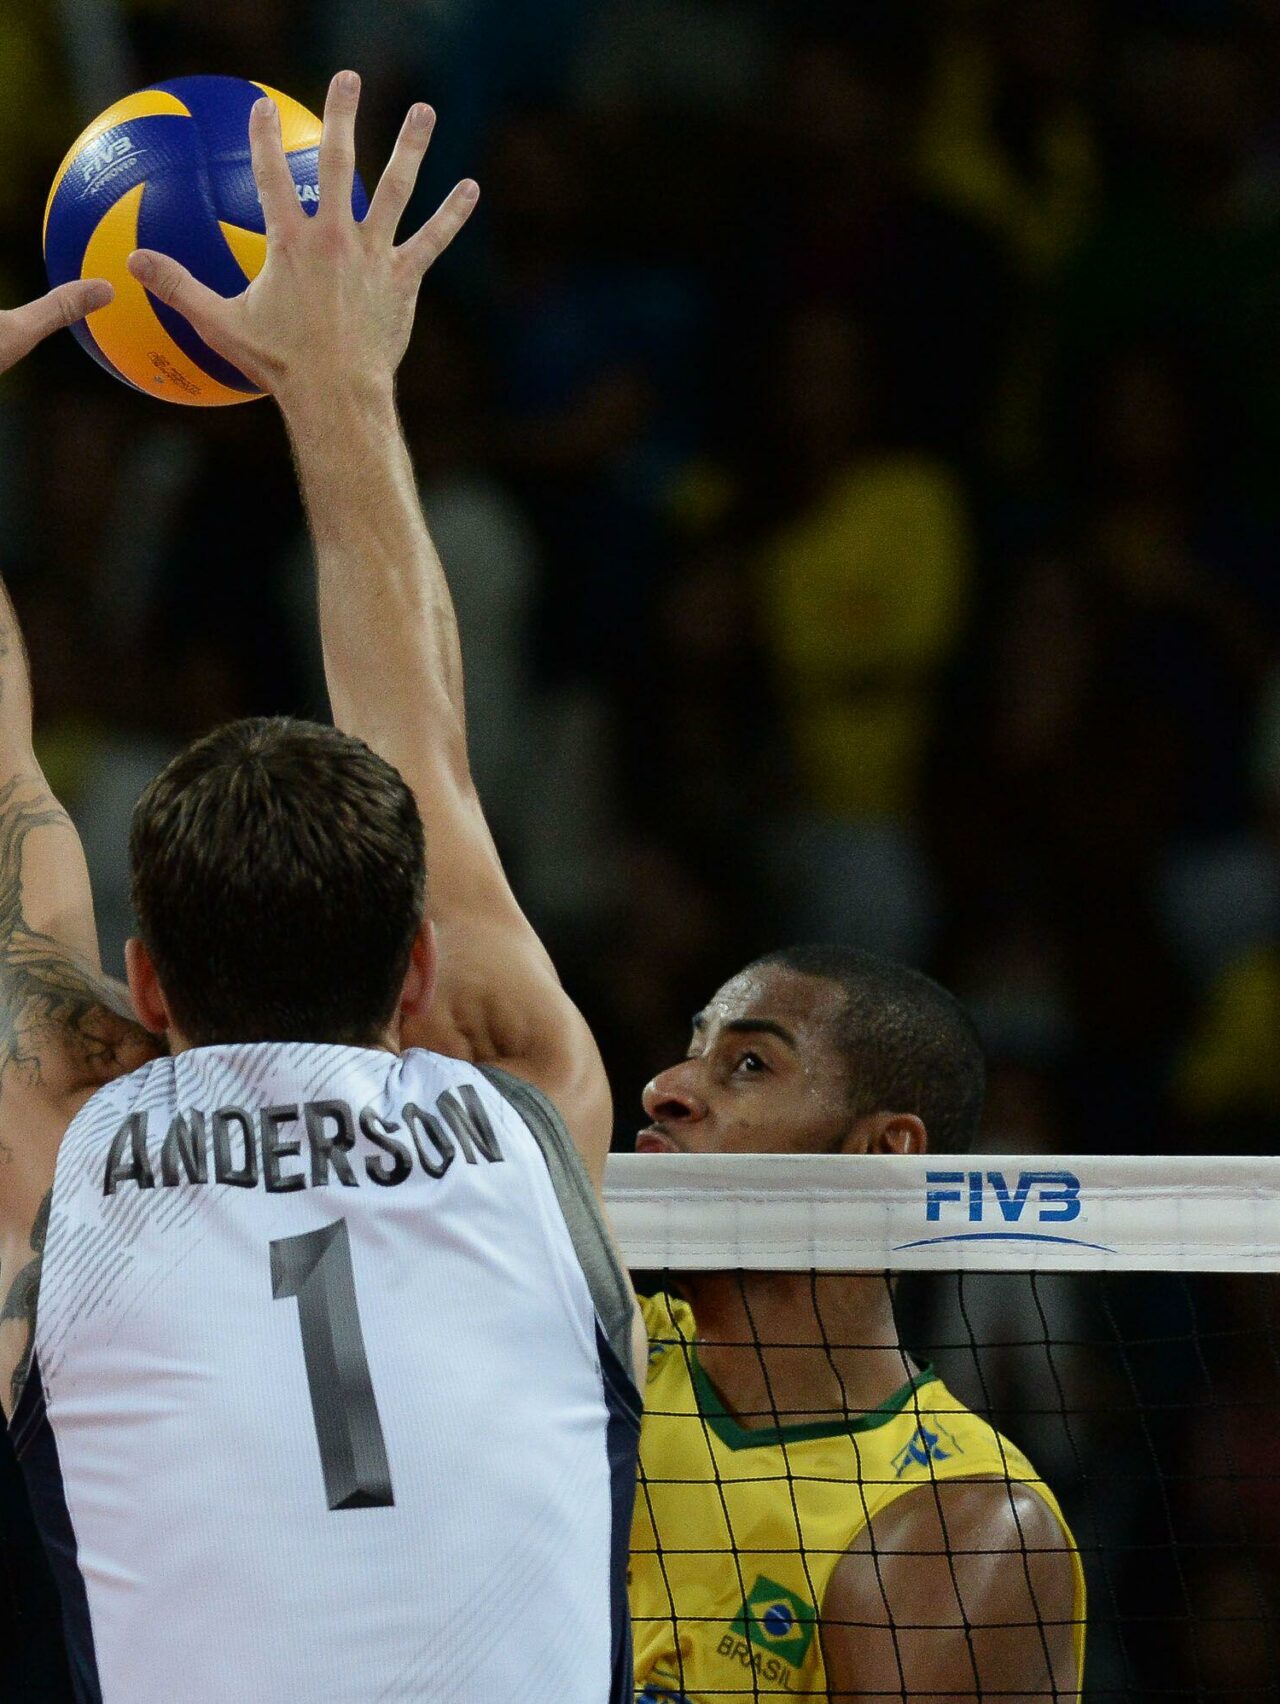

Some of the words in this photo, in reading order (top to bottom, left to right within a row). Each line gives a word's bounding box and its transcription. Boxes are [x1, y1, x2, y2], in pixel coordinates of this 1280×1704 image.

[103, 1084, 504, 1197] ANDERSON
[926, 1171, 1082, 1222] FIVB
[269, 1216, 395, 1511] 1
[717, 1634, 794, 1691] BRASIL
